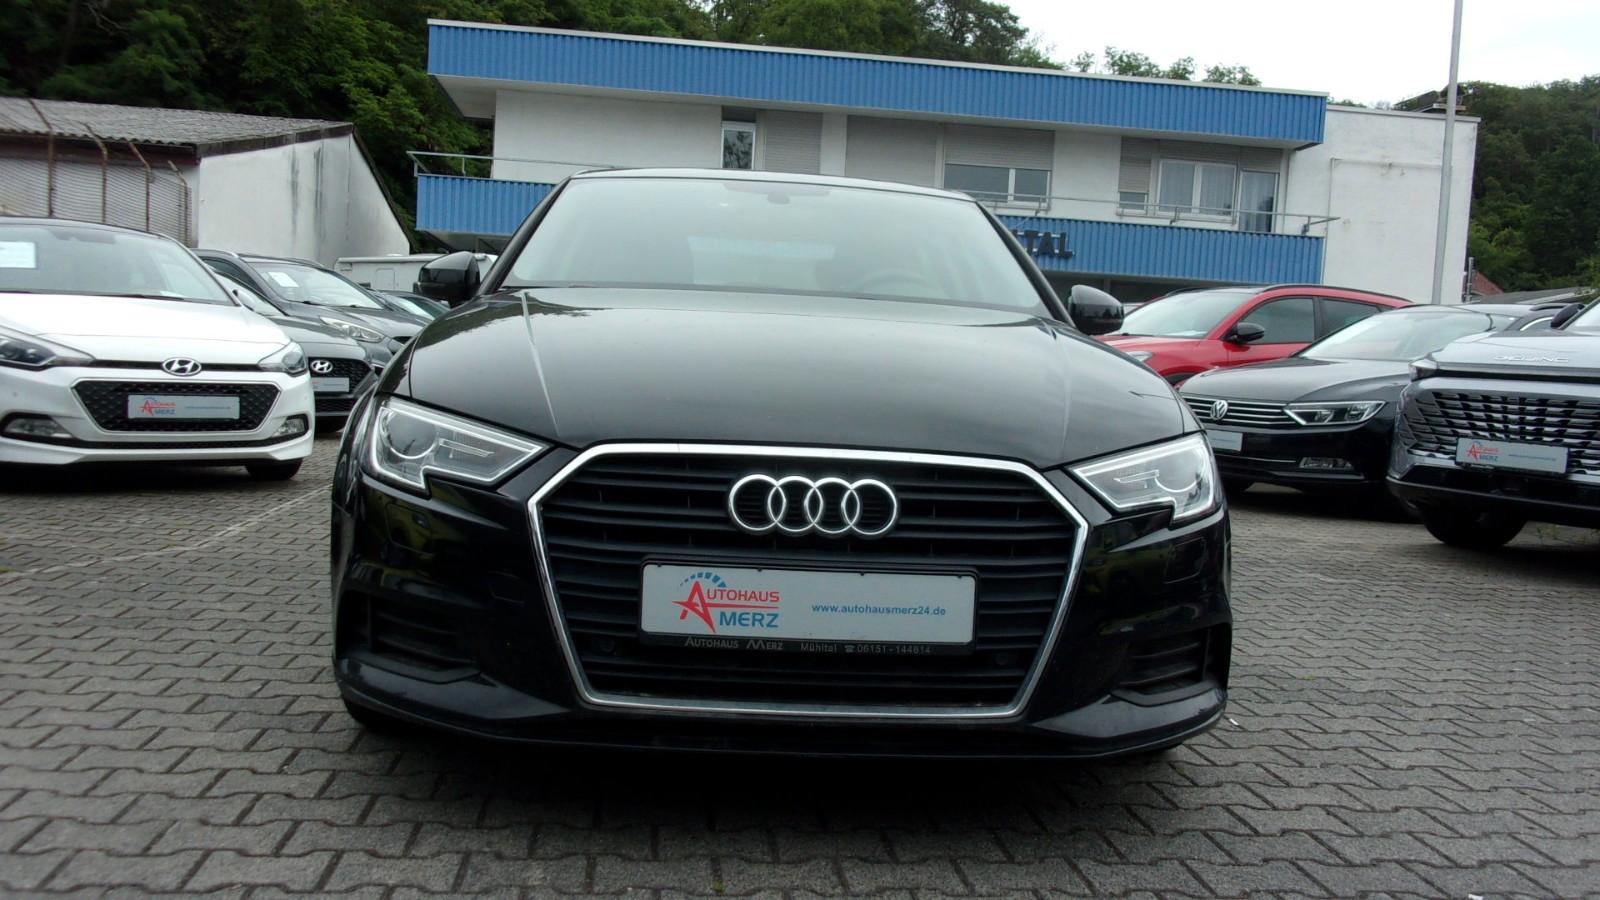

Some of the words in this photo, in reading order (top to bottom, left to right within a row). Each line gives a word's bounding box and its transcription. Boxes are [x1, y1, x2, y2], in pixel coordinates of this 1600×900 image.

[674, 580, 780, 633] AUTOHAUS
[811, 604, 946, 616] www.autohausmerz24.de
[720, 611, 779, 628] MERZ
